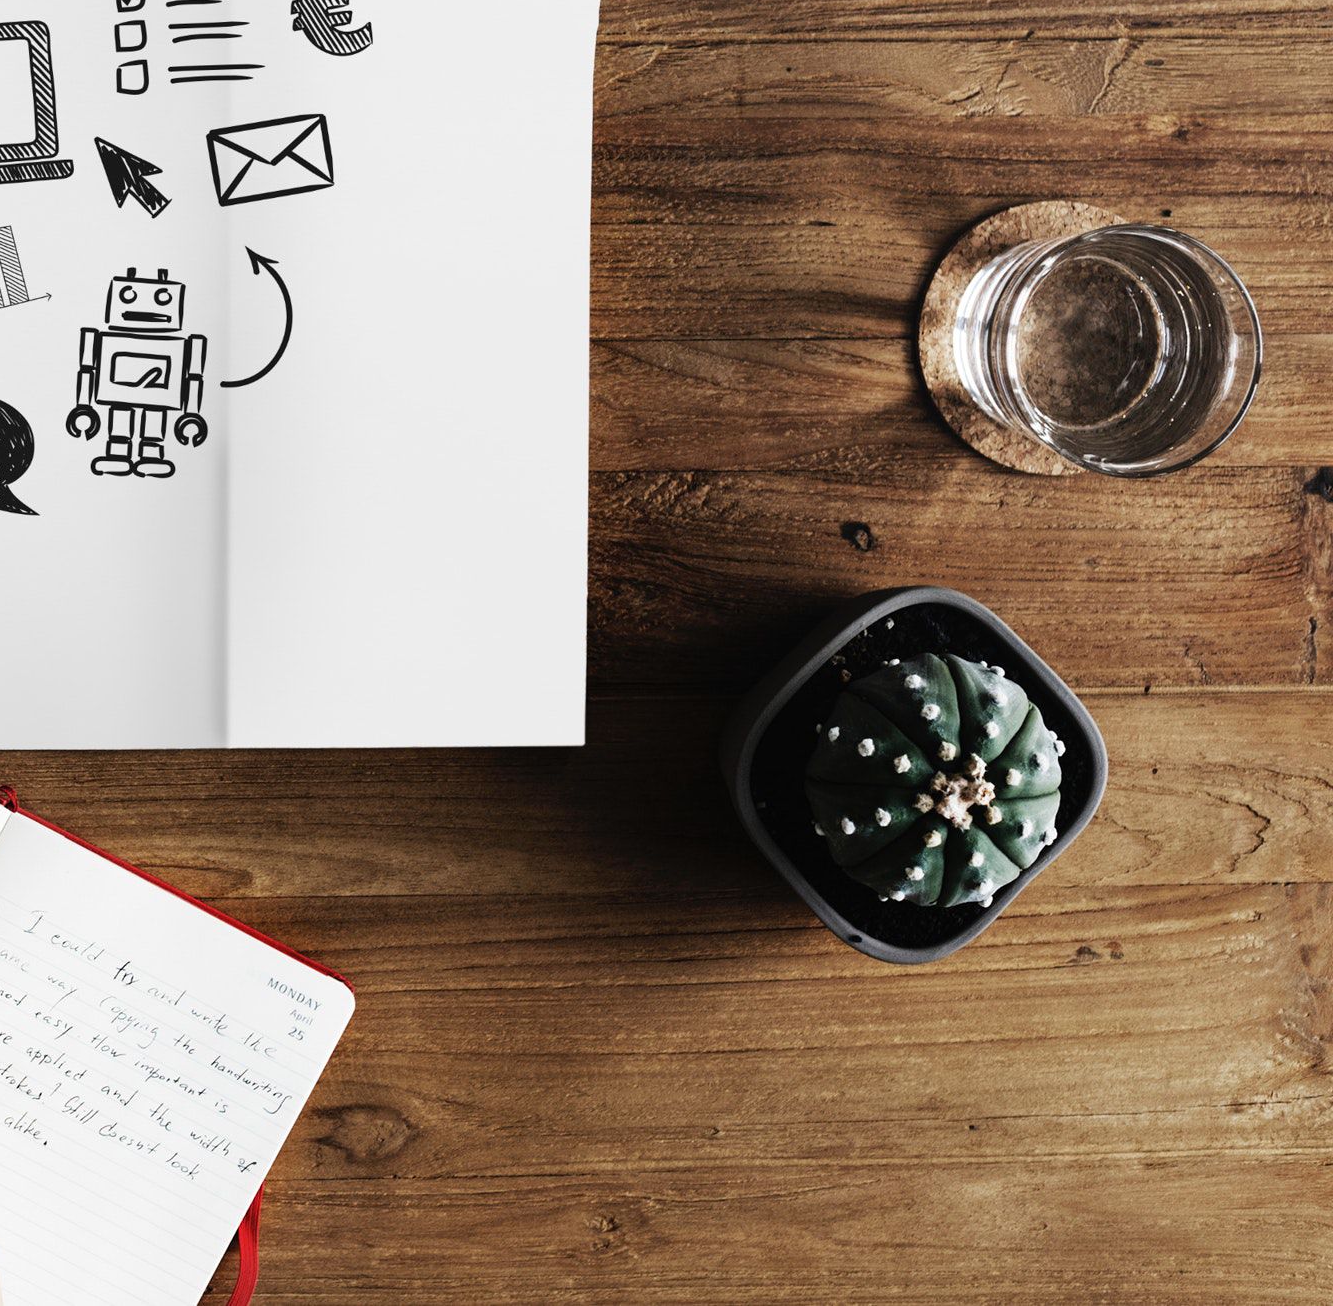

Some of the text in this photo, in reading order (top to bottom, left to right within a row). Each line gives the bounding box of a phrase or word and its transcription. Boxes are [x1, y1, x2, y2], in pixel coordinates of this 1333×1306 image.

[50, 934, 105, 961] could
[113, 960, 135, 985] try
[147, 987, 186, 1006] and
[191, 1009, 227, 1035] write
[243, 1032, 271, 1057] the
[267, 977, 320, 1010] MONDAY
[289, 1009, 313, 1026] April
[287, 1027, 303, 1041] 25
[26, 1047, 87, 1081] applied
[100, 1085, 138, 1106] and
[149, 1102, 171, 1131] the
[189, 1131, 230, 1156] width
[134, 1061, 206, 1096] important
[214, 1099, 228, 1113] is
[174, 1034, 194, 1055] the
[210, 1055, 292, 1114] handwriting
[61, 1095, 99, 1124] Still
[98, 1122, 160, 1154] doesn't
[165, 1152, 199, 1180] look
